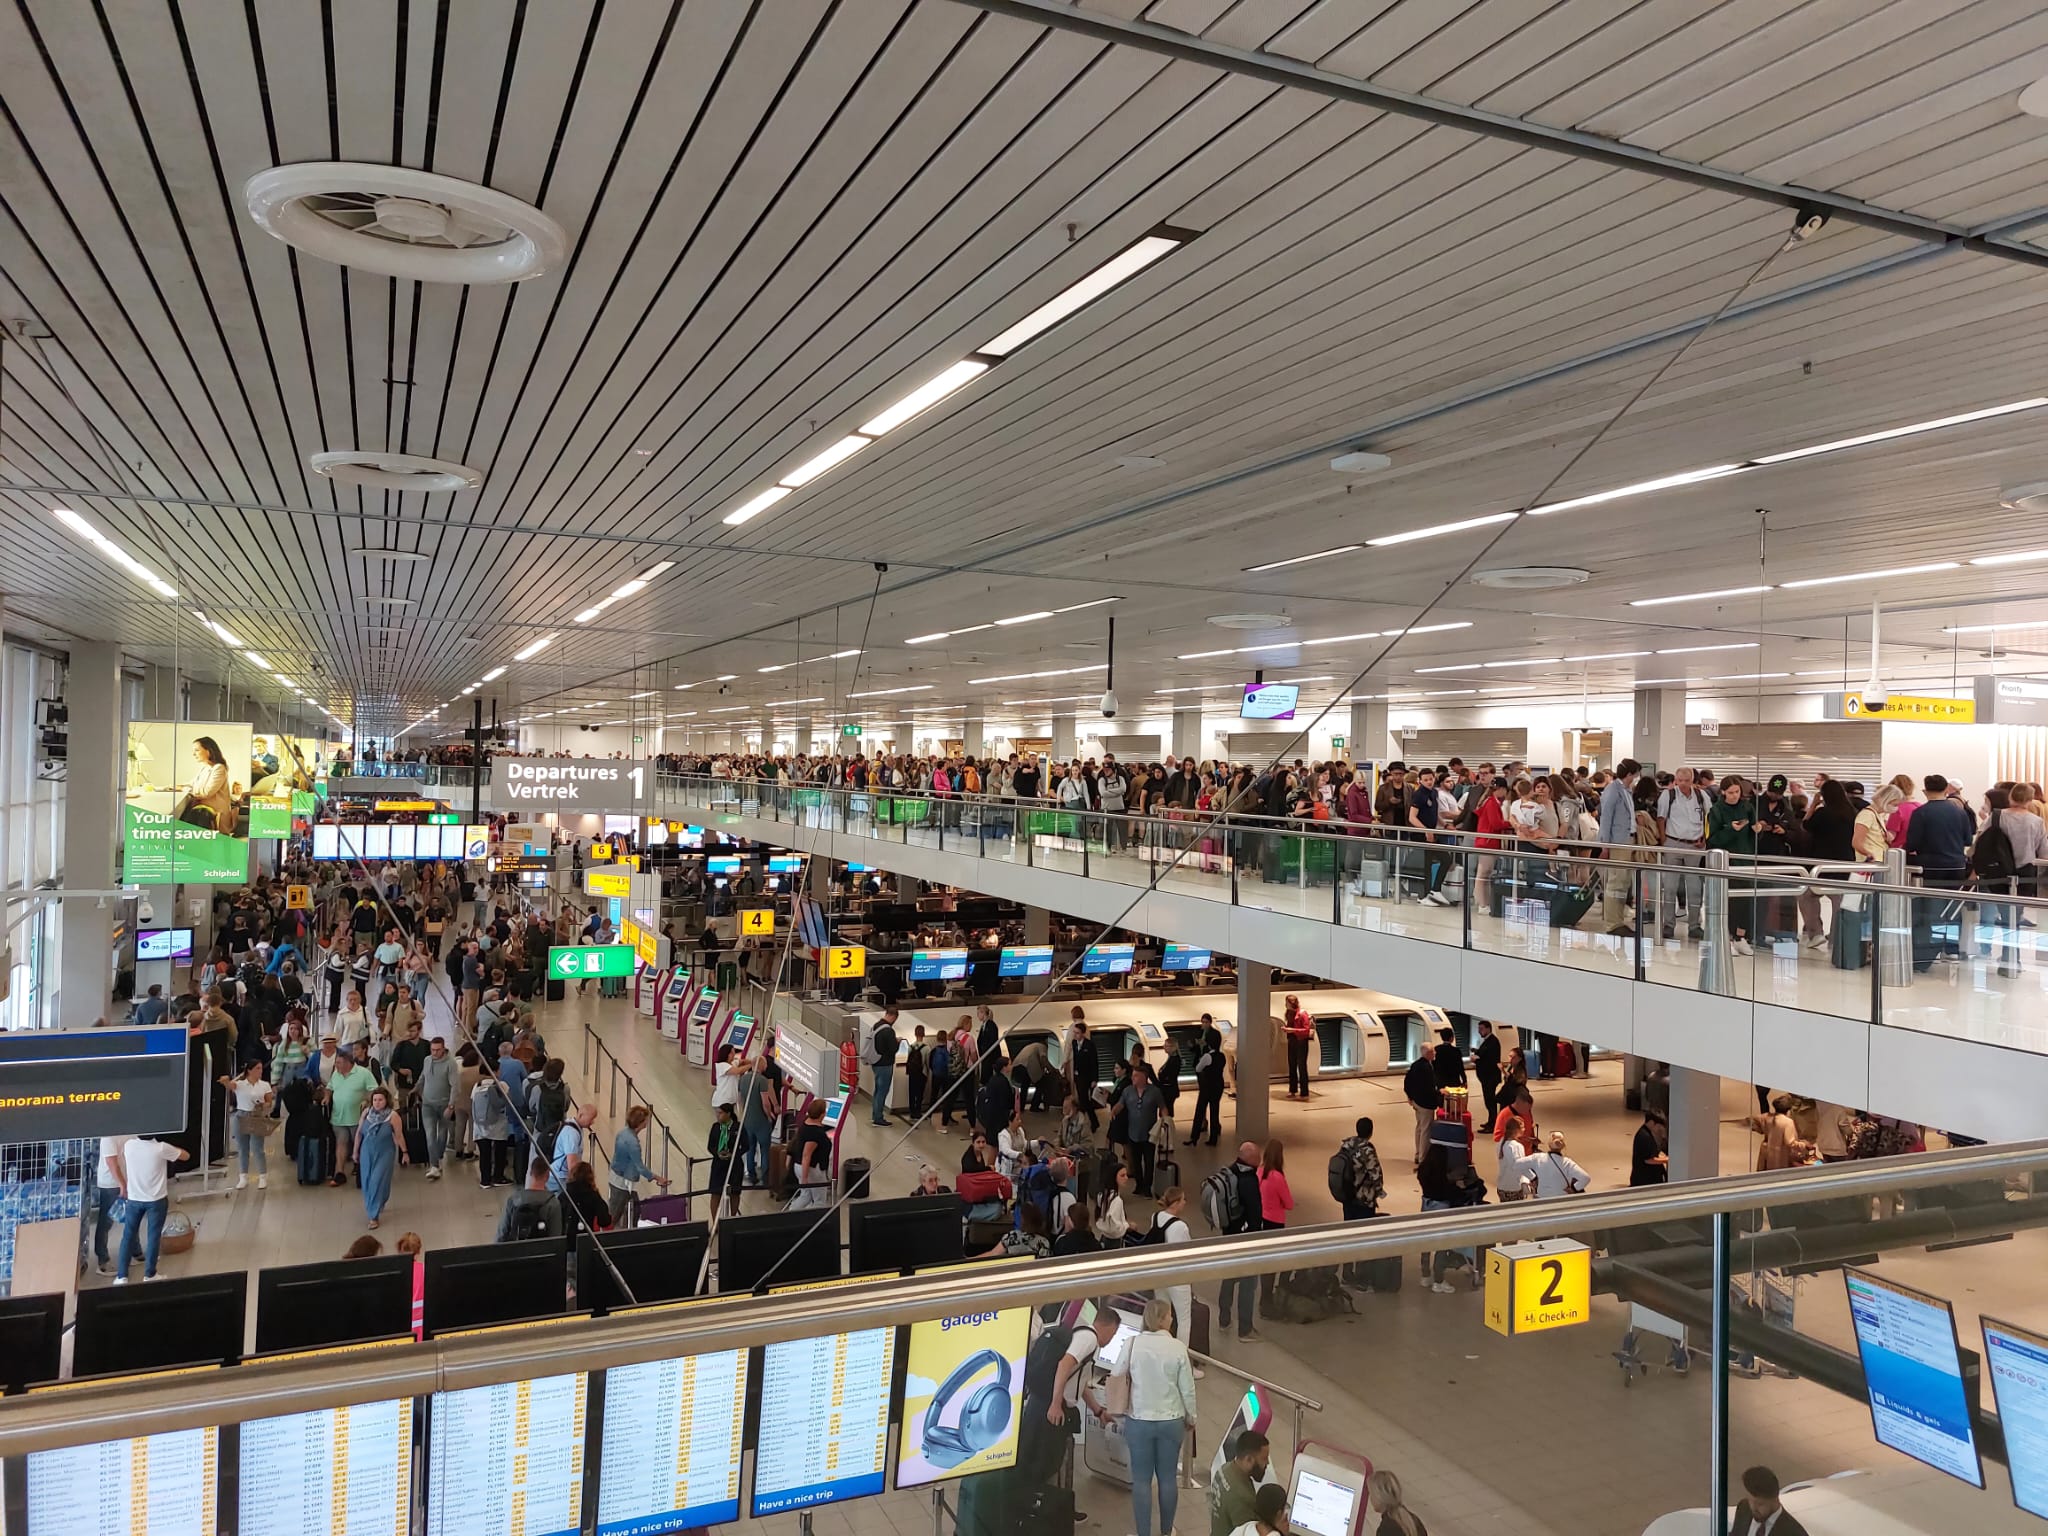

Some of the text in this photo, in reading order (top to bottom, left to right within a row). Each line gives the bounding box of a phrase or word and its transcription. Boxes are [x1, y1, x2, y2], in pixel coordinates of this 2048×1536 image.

[507, 763, 644, 800] Departures 1
[506, 782, 580, 799] Vertrek
[261, 802, 287, 810] zone
[132, 811, 174, 825] Your
[131, 827, 220, 840] time saver
[598, 845, 605, 855] 6
[203, 869, 240, 878] Schiphol
[752, 912, 763, 928] 4
[840, 950, 852, 969] 3
[69, 1090, 122, 1103] terrace
[1493, 1260, 1501, 1275] 2
[1540, 1260, 1564, 1306] 2
[941, 1310, 999, 1331] gadget
[1539, 1308, 1578, 1324] Check-in
[1887, 1400, 1941, 1427] Liquids & gels
[985, 1450, 1013, 1461] Schiphol
[759, 1500, 784, 1510] Have
[794, 1493, 814, 1503] nice
[816, 1489, 834, 1500] trip
[631, 1527, 638, 1535] a
[641, 1522, 662, 1533] nice
[664, 1518, 683, 1529] trip
